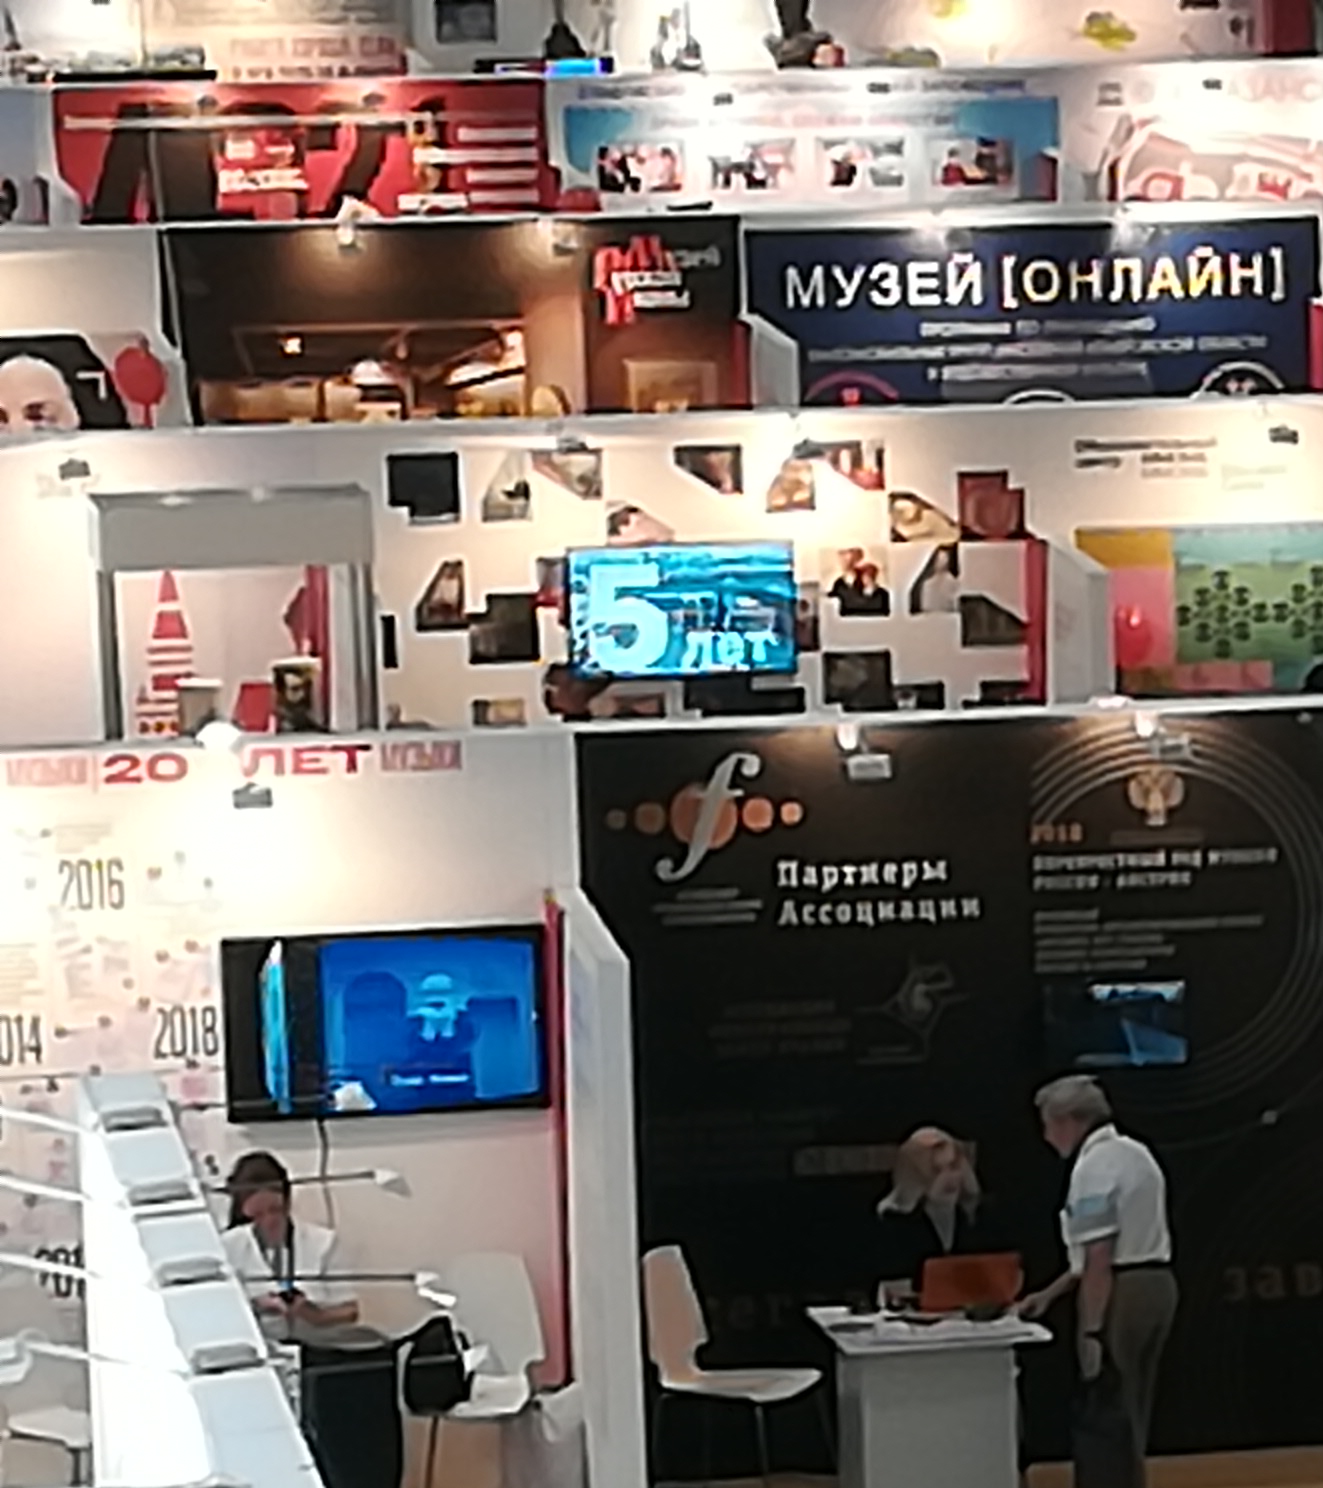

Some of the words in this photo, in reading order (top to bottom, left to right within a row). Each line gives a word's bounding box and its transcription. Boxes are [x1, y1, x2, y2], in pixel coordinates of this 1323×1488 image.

[786, 252, 984, 309] МУЗЕЙ
[1000, 245, 1285, 310] [ОНЛАЙН]
[588, 562, 669, 675] 5
[103, 752, 189, 784] 20
[241, 743, 371, 778] ЛЕТ
[58, 857, 125, 911] 2016
[776, 859, 947, 893] Партнеры
[777, 897, 981, 927] Ассоциации
[0, 1014, 43, 1066] 014
[153, 1004, 219, 1060] 2018
